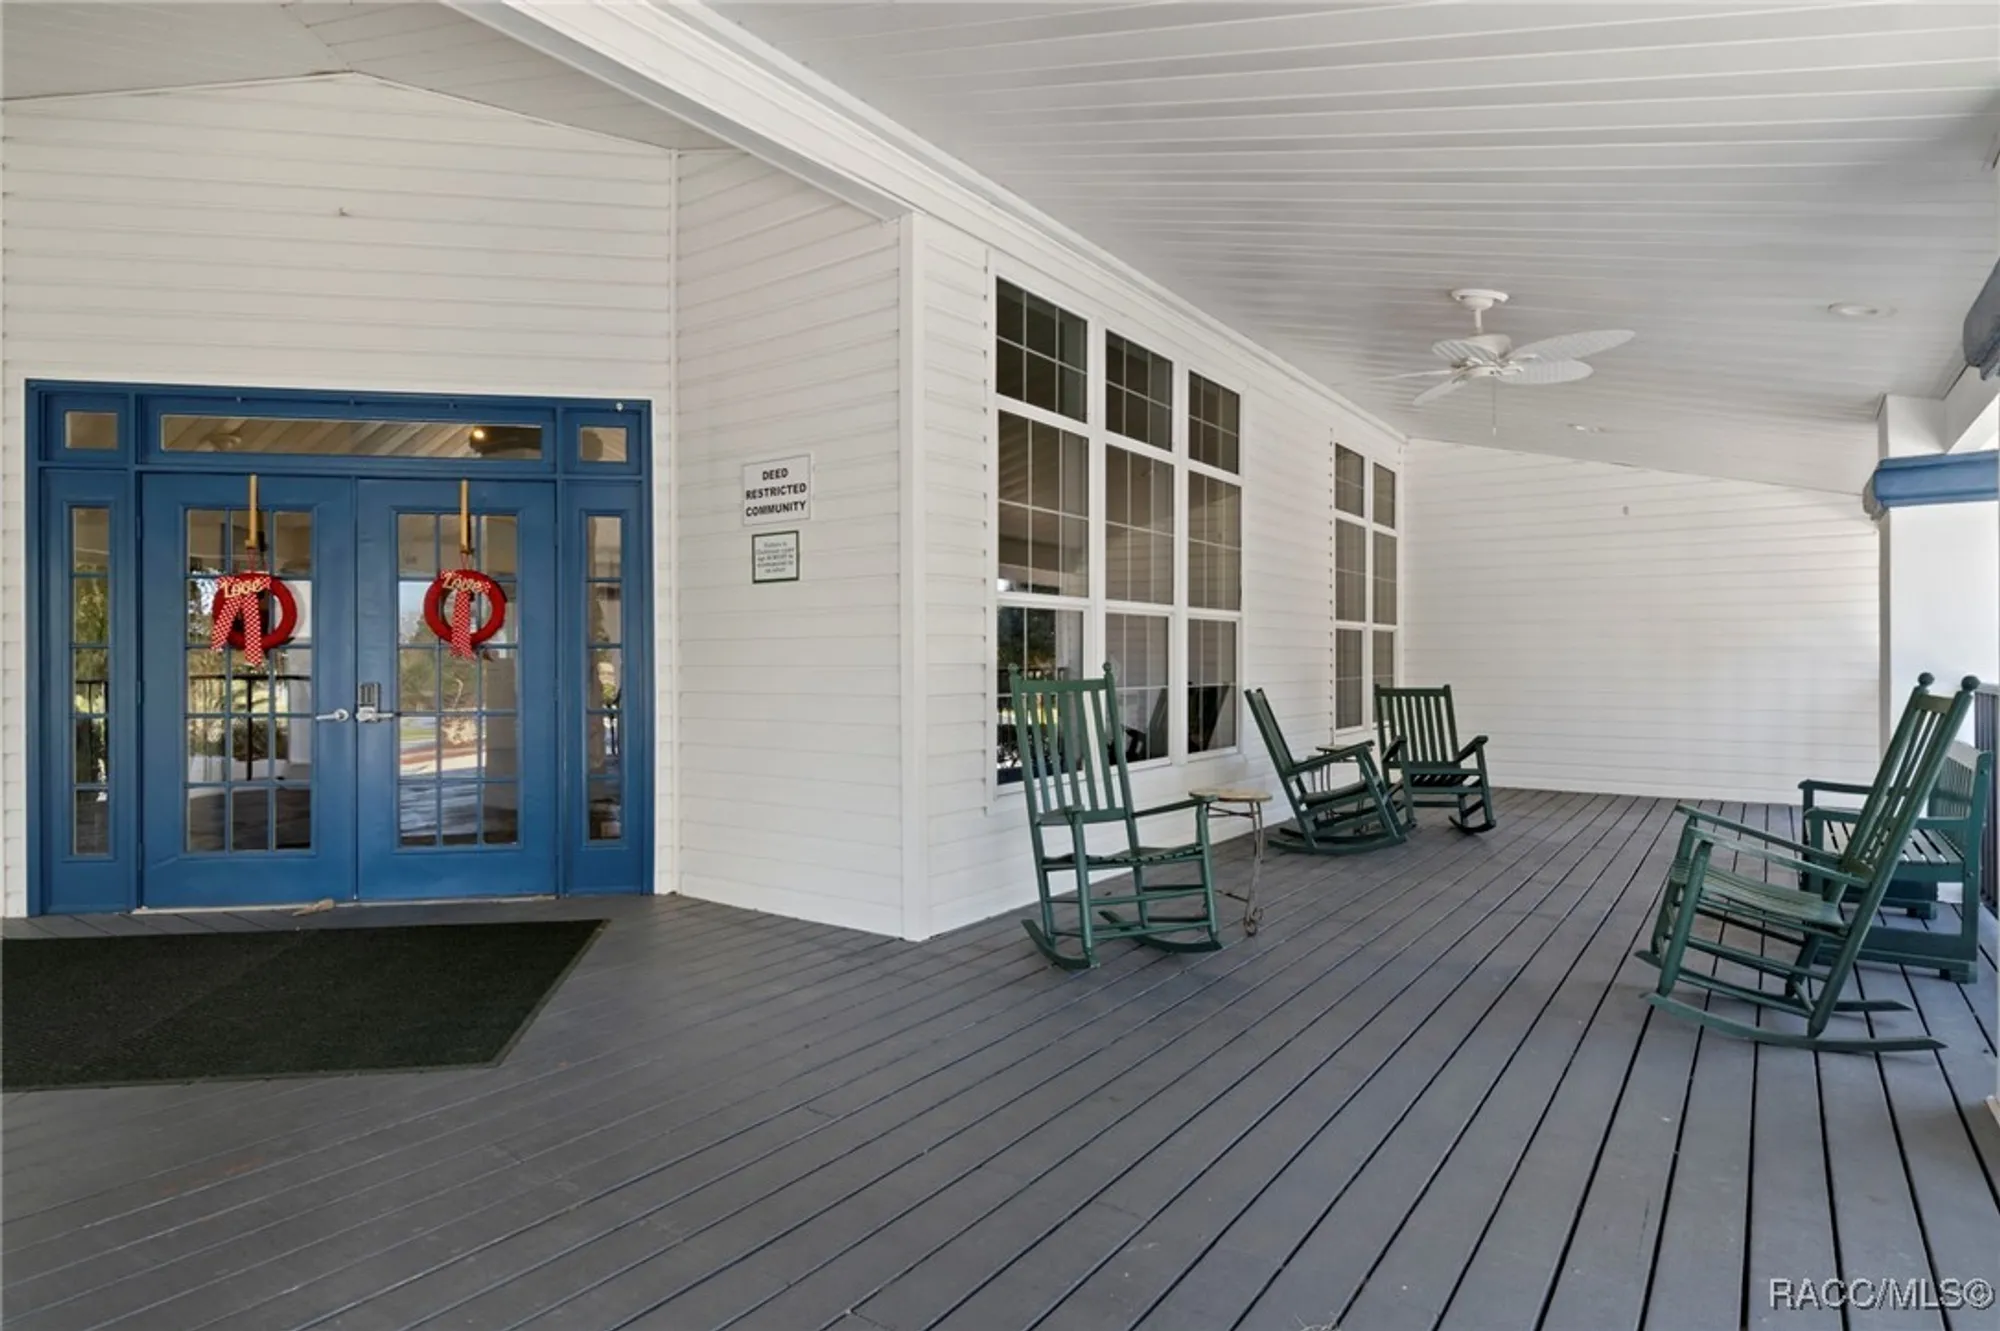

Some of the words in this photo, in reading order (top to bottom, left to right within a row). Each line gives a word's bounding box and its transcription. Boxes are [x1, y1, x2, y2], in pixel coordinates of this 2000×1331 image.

[762, 467, 789, 481] DEED
[745, 483, 807, 500] RESTRICTED
[745, 500, 806, 517] COMMUNITY
